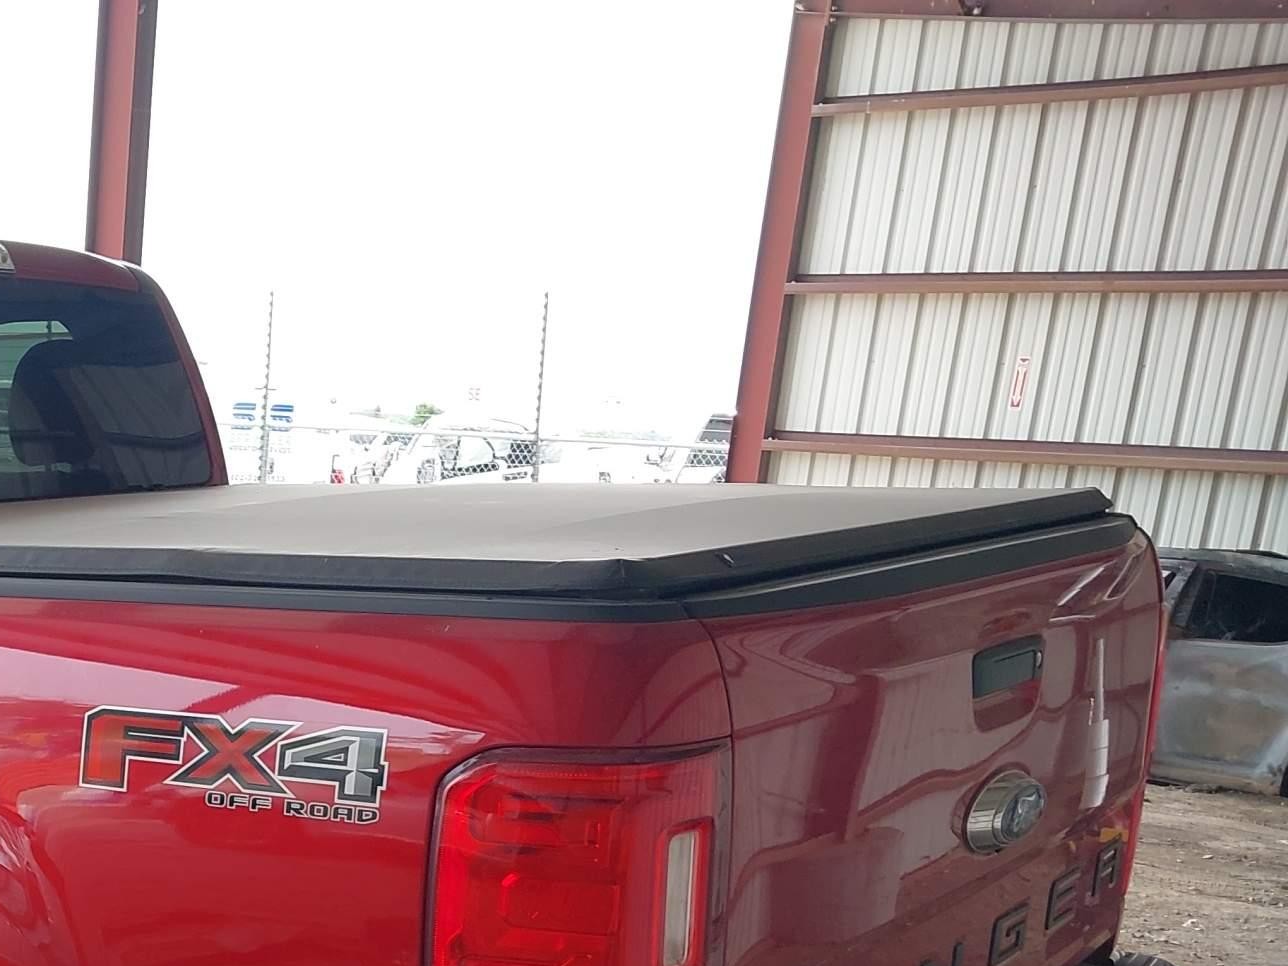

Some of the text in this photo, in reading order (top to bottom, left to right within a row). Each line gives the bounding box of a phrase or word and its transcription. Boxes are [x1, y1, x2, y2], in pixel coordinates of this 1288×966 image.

[79, 705, 388, 807] FX4
[206, 791, 380, 824] OFF ROAD
